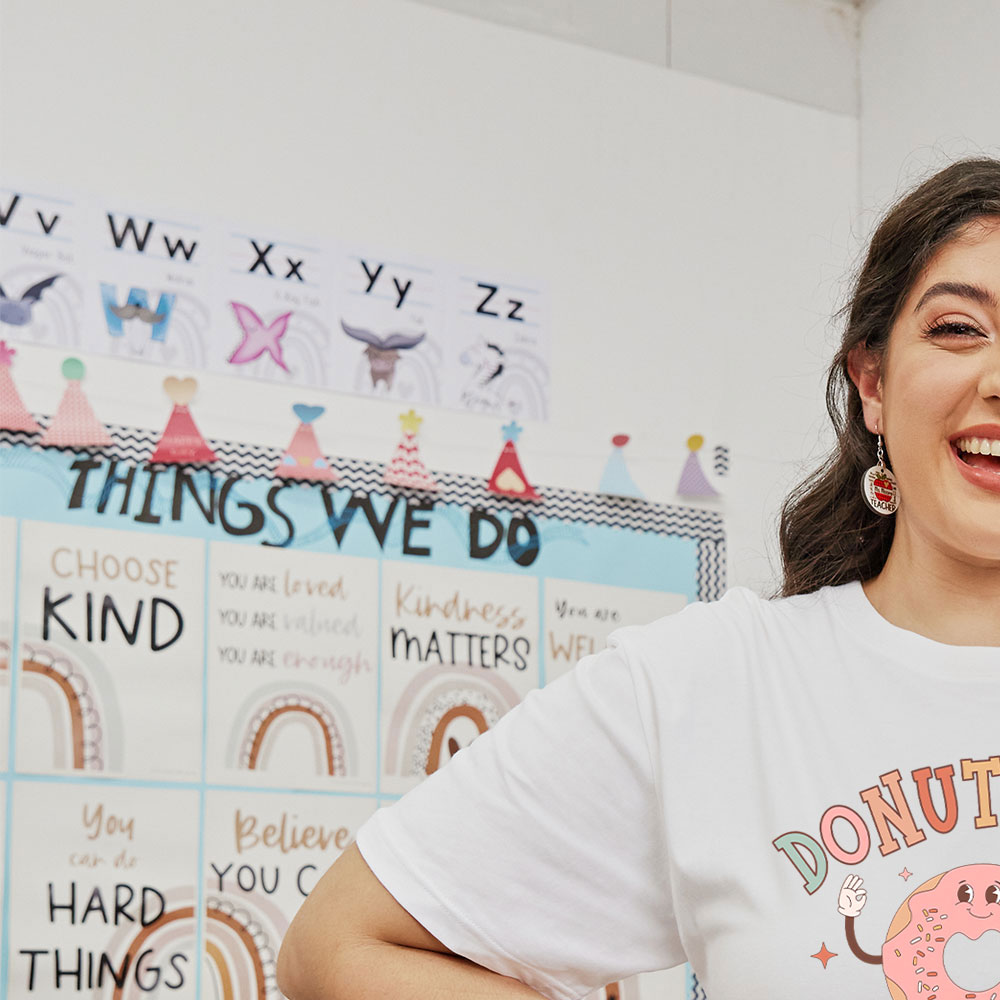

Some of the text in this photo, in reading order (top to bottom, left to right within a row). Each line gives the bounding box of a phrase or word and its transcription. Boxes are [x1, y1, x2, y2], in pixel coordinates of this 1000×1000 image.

[68, 459, 541, 567] THINGS WE DO
[51, 547, 179, 590] CHOOSE
[219, 568, 347, 601] YOU ARE loved
[43, 586, 184, 652] KIND
[218, 608, 248, 629] YOU
[252, 611, 277, 630] ARE
[395, 582, 528, 631] Kindness
[555, 599, 588, 619] You
[217, 645, 373, 687] YOU ARE enough
[391, 627, 531, 671] MATTERS
[82, 803, 136, 842] You
[234, 809, 350, 855] Believe
[69, 850, 139, 870] can do
[211, 863, 280, 895] YOU
[48, 881, 166, 928] HARD
[19, 947, 190, 992] THINGS
